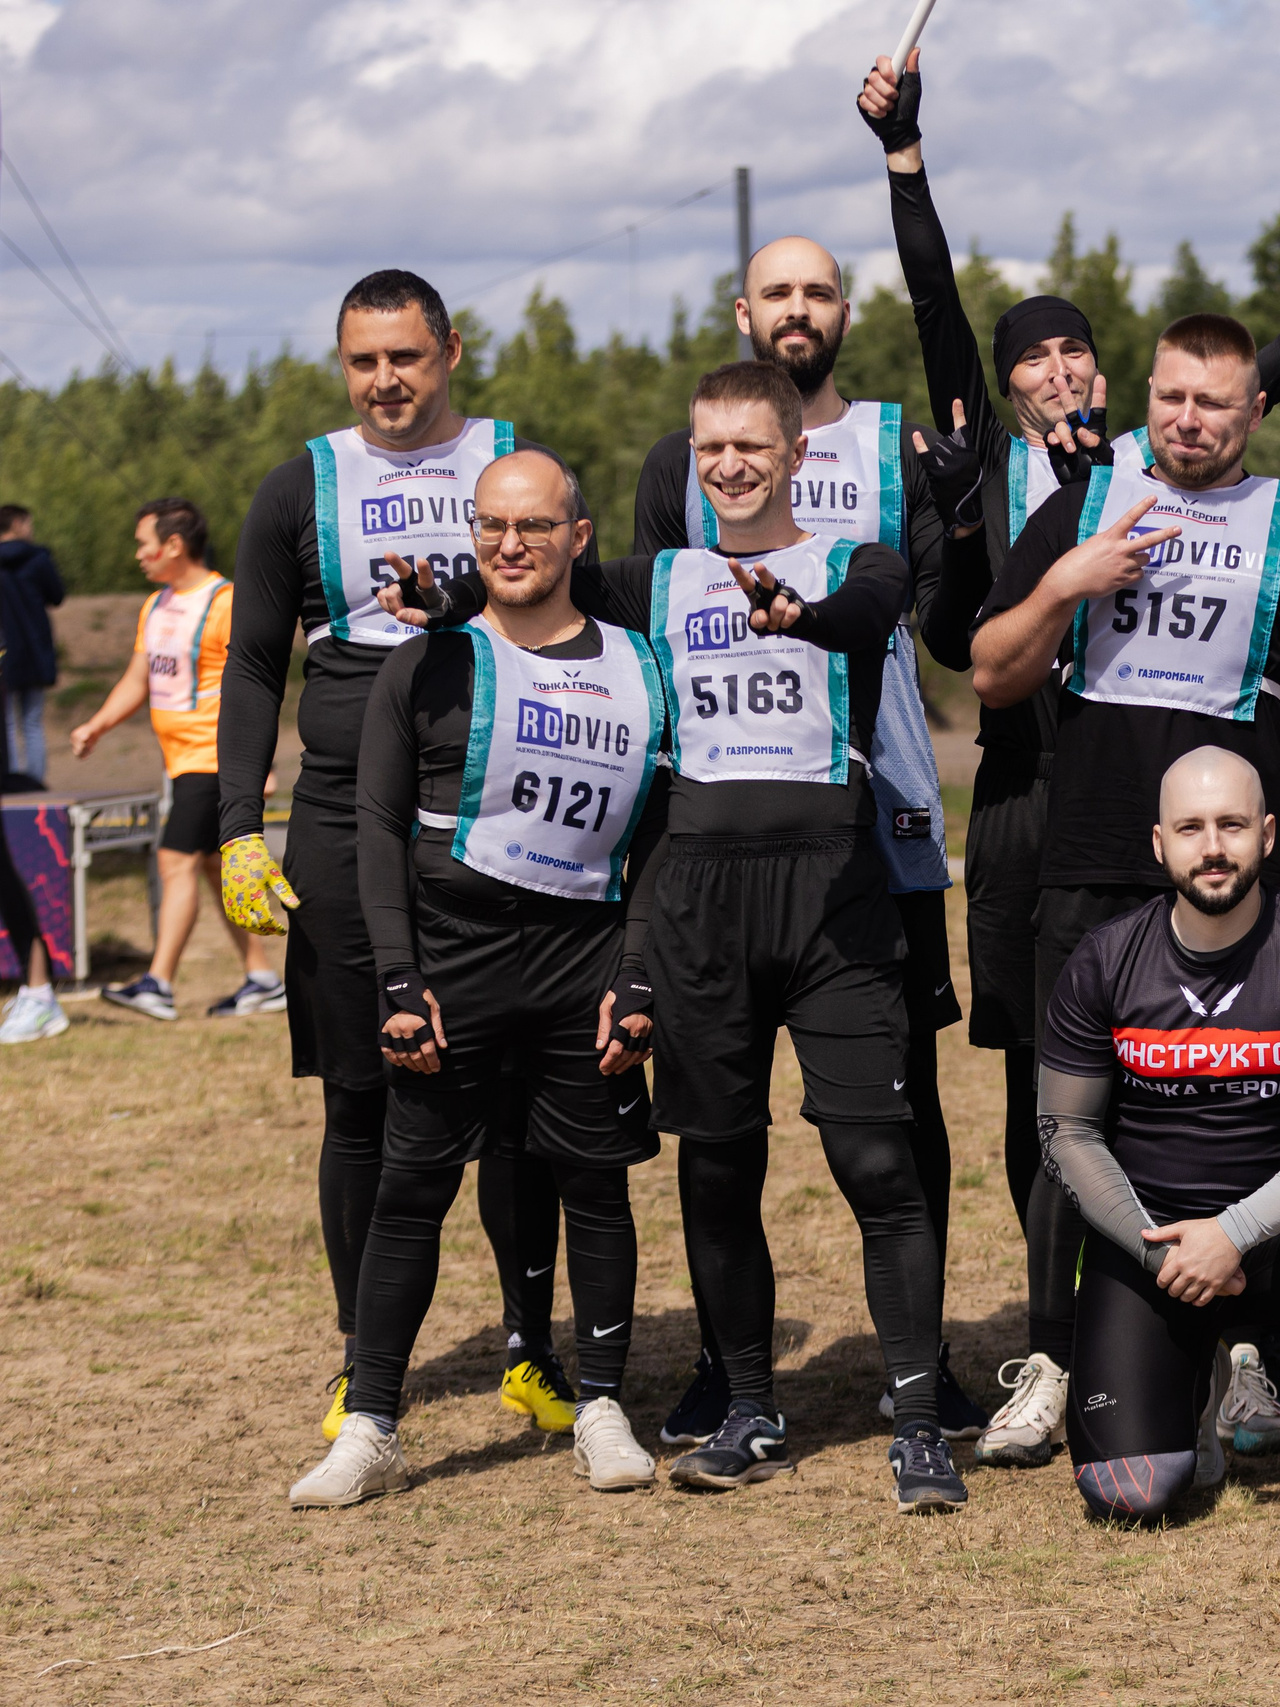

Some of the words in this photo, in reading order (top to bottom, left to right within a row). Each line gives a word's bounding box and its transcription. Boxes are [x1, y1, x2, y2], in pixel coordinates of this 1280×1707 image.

[804, 451, 837, 459] ЕРОЕВ
[379, 470, 412, 483] ГОНКА
[415, 468, 455, 476] ГЕРОЕВ
[791, 480, 857, 510] DVIG
[365, 497, 476, 530] RODVIG
[1147, 505, 1182, 514] ОНКА
[1186, 508, 1226, 522] ГЕРОЕВ
[1127, 531, 1242, 569] DVIG
[1112, 588, 1228, 642] 5157
[532, 681, 570, 692] ГОНКА
[572, 681, 610, 696] ГЕРОЕВ
[1138, 668, 1204, 684] ГАЗПРОМБАНК
[690, 670, 803, 720] 5163
[522, 706, 630, 757] RODVIG
[726, 746, 793, 756] ГАЗПРОМБАНК
[512, 770, 612, 832] 6121
[526, 850, 584, 872] ГАЗПРОМБАНК
